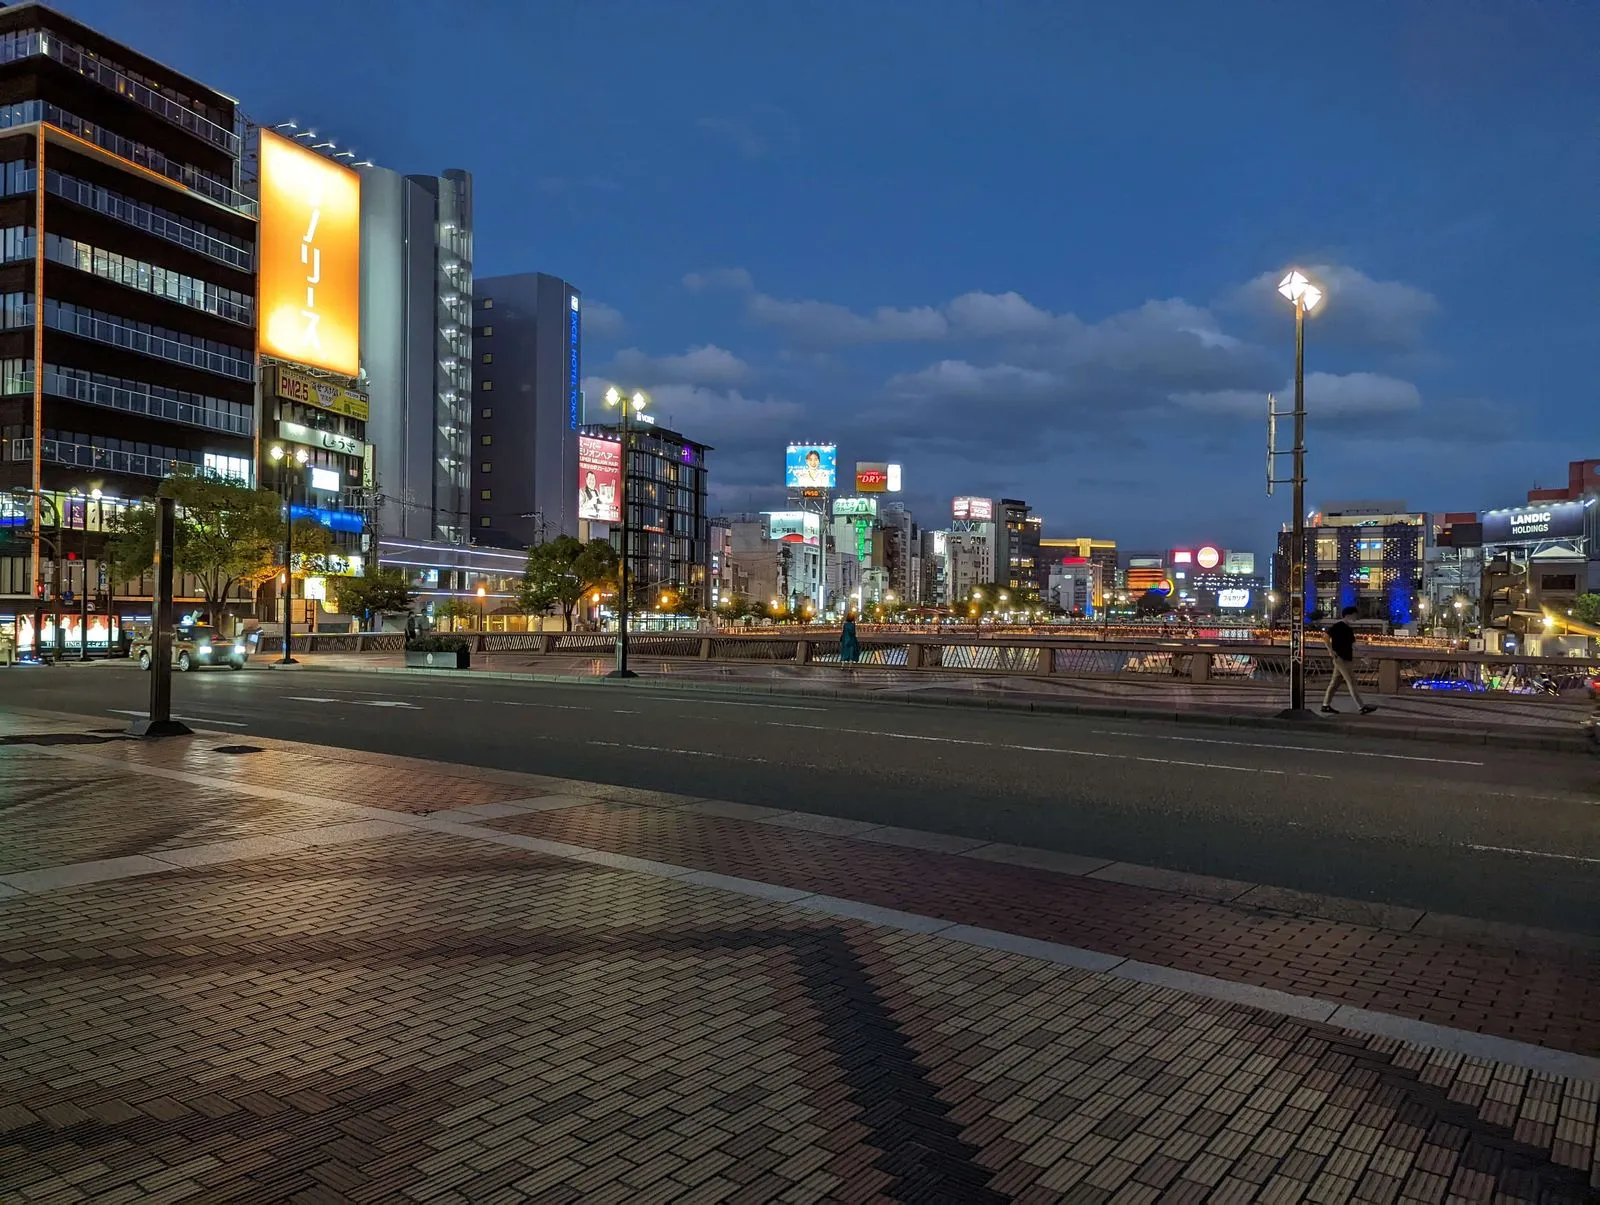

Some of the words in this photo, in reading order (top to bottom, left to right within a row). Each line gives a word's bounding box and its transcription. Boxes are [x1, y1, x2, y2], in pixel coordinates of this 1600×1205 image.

[571, 311, 579, 345] EXCEL
[281, 375, 309, 401] PM2.5
[570, 389, 578, 431] TOKYU
[1510, 512, 1551, 524] LANDIC
[1512, 524, 1549, 534] HOLDINGS
